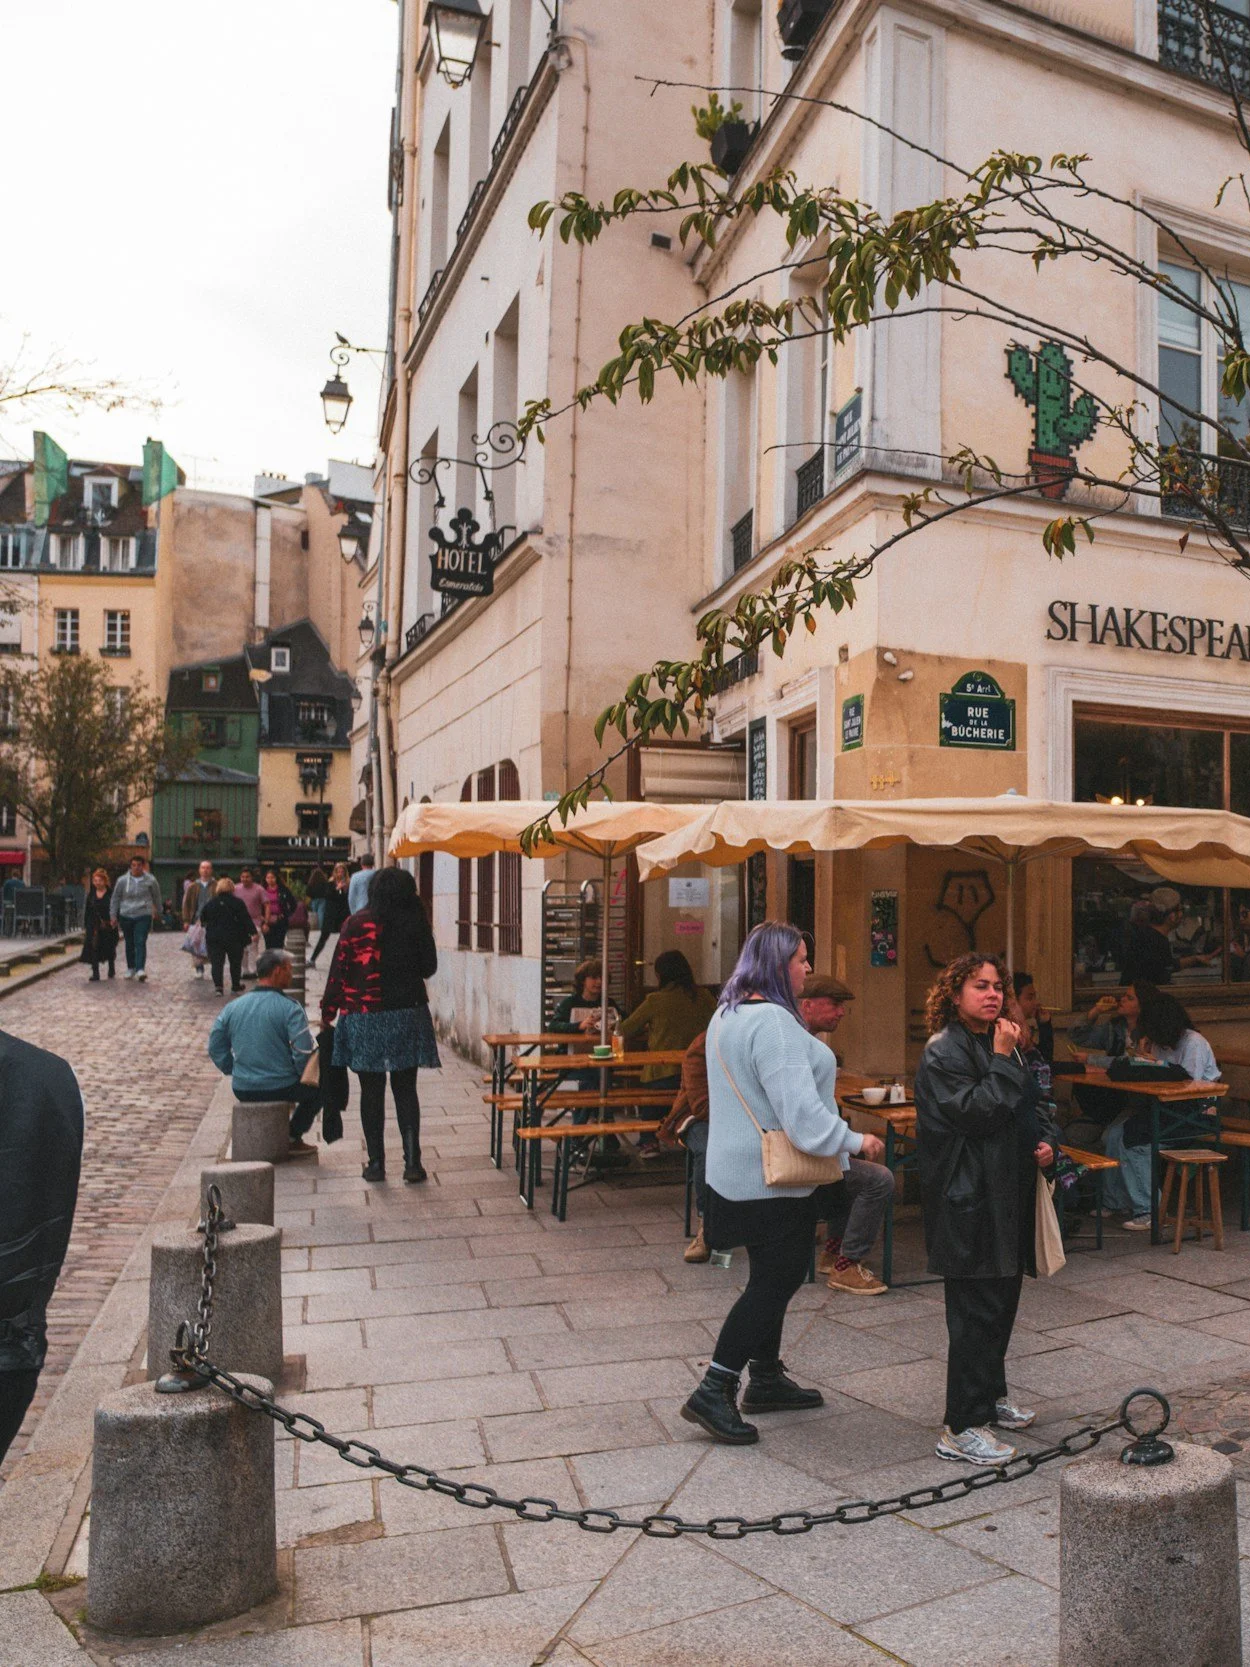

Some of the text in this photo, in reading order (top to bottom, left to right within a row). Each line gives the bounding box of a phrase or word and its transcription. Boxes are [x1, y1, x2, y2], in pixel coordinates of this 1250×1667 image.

[437, 548, 487, 574] HOTEL
[967, 706, 989, 718] RUE
[951, 724, 1004, 740] BÛCHERIE
